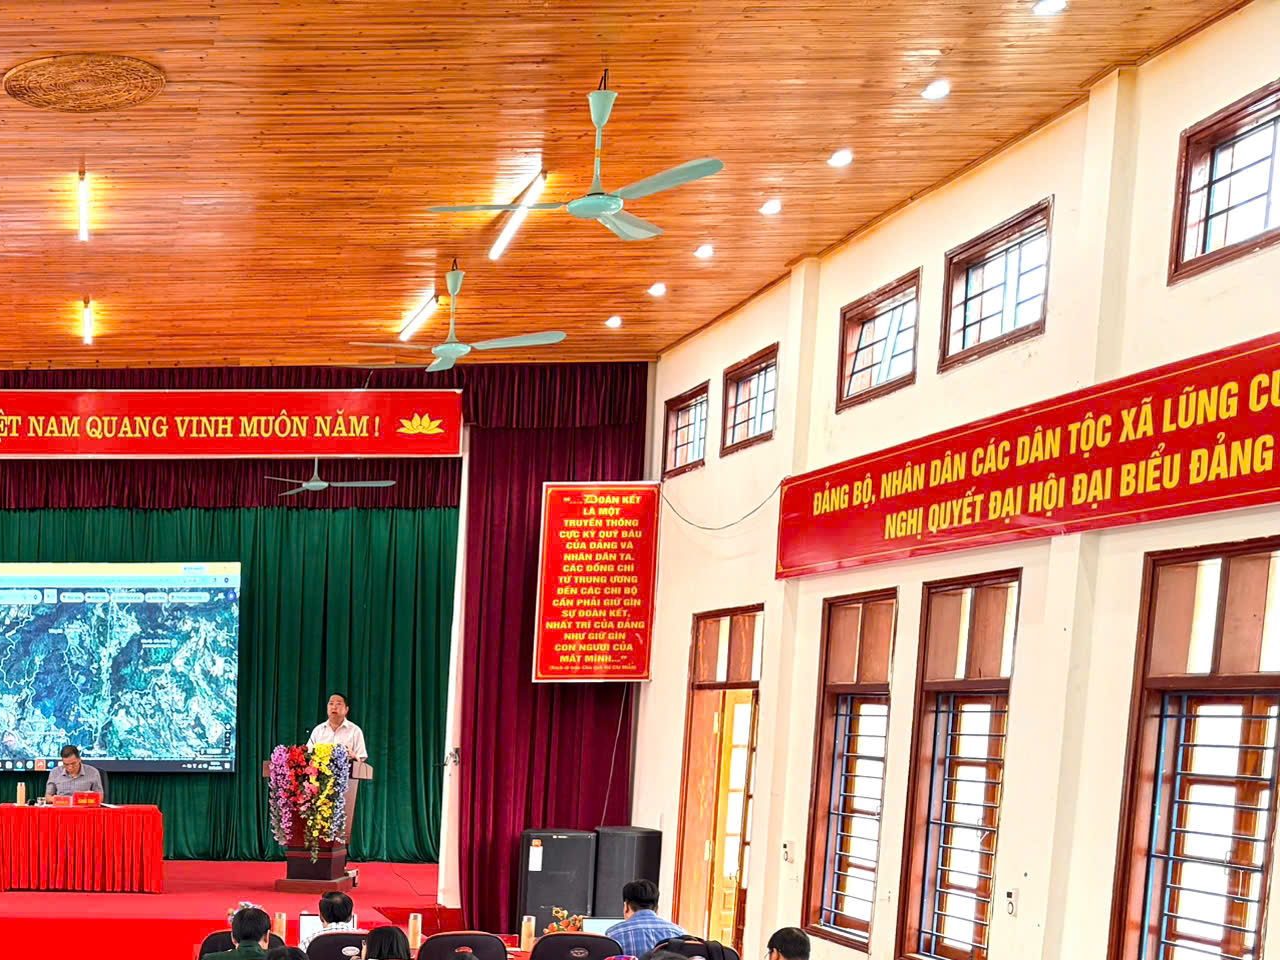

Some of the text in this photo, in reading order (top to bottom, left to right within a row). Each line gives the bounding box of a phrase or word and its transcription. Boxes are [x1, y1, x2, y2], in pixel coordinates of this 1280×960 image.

[27, 416, 80, 437] NAM
[85, 416, 168, 439] QUANG
[174, 417, 234, 437] VINH
[238, 409, 309, 437] MUÔN
[314, 408, 369, 437] NĂM
[812, 481, 849, 516] ĐẢNG
[852, 473, 876, 509] BỘ,
[880, 461, 926, 499] NHÂN
[929, 451, 967, 487] DÂN
[971, 437, 1011, 477] CÁC
[1015, 425, 1061, 467] DÂN
[1068, 411, 1112, 459] TỘC
[1119, 396, 1154, 443] XÃ
[1162, 381, 1239, 433] LŨNG
[884, 432, 1275, 540] NGHỊ QUYẾT ĐẠI HỘI ĐẠI BIỂU ĐẢNG
